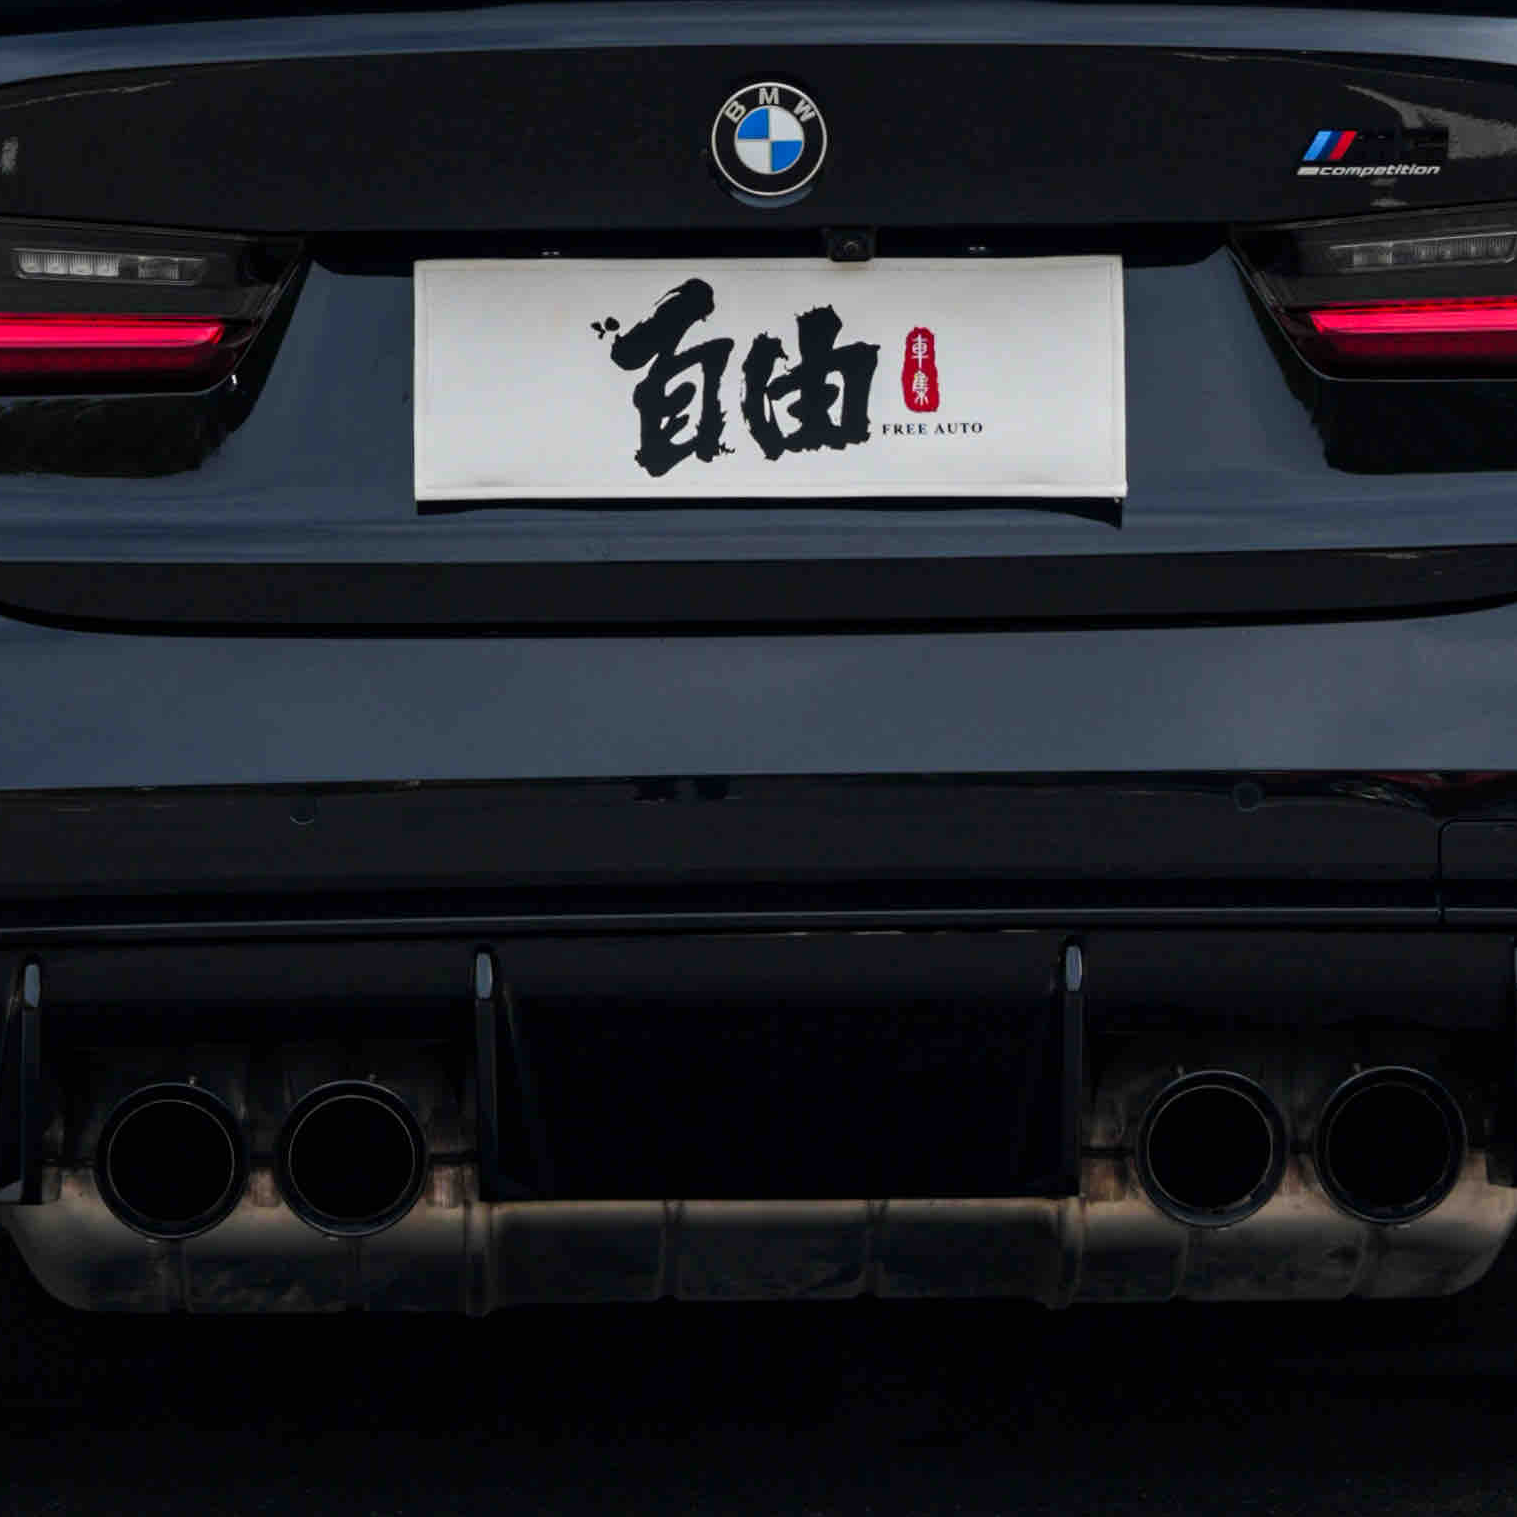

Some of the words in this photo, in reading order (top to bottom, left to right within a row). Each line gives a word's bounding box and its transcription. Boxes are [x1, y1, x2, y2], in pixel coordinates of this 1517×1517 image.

[724, 87, 816, 123] BMW
[1319, 164, 1441, 177] competition
[591, 278, 880, 477] 自由
[882, 422, 927, 435] FREE
[934, 422, 984, 434] AUTO
